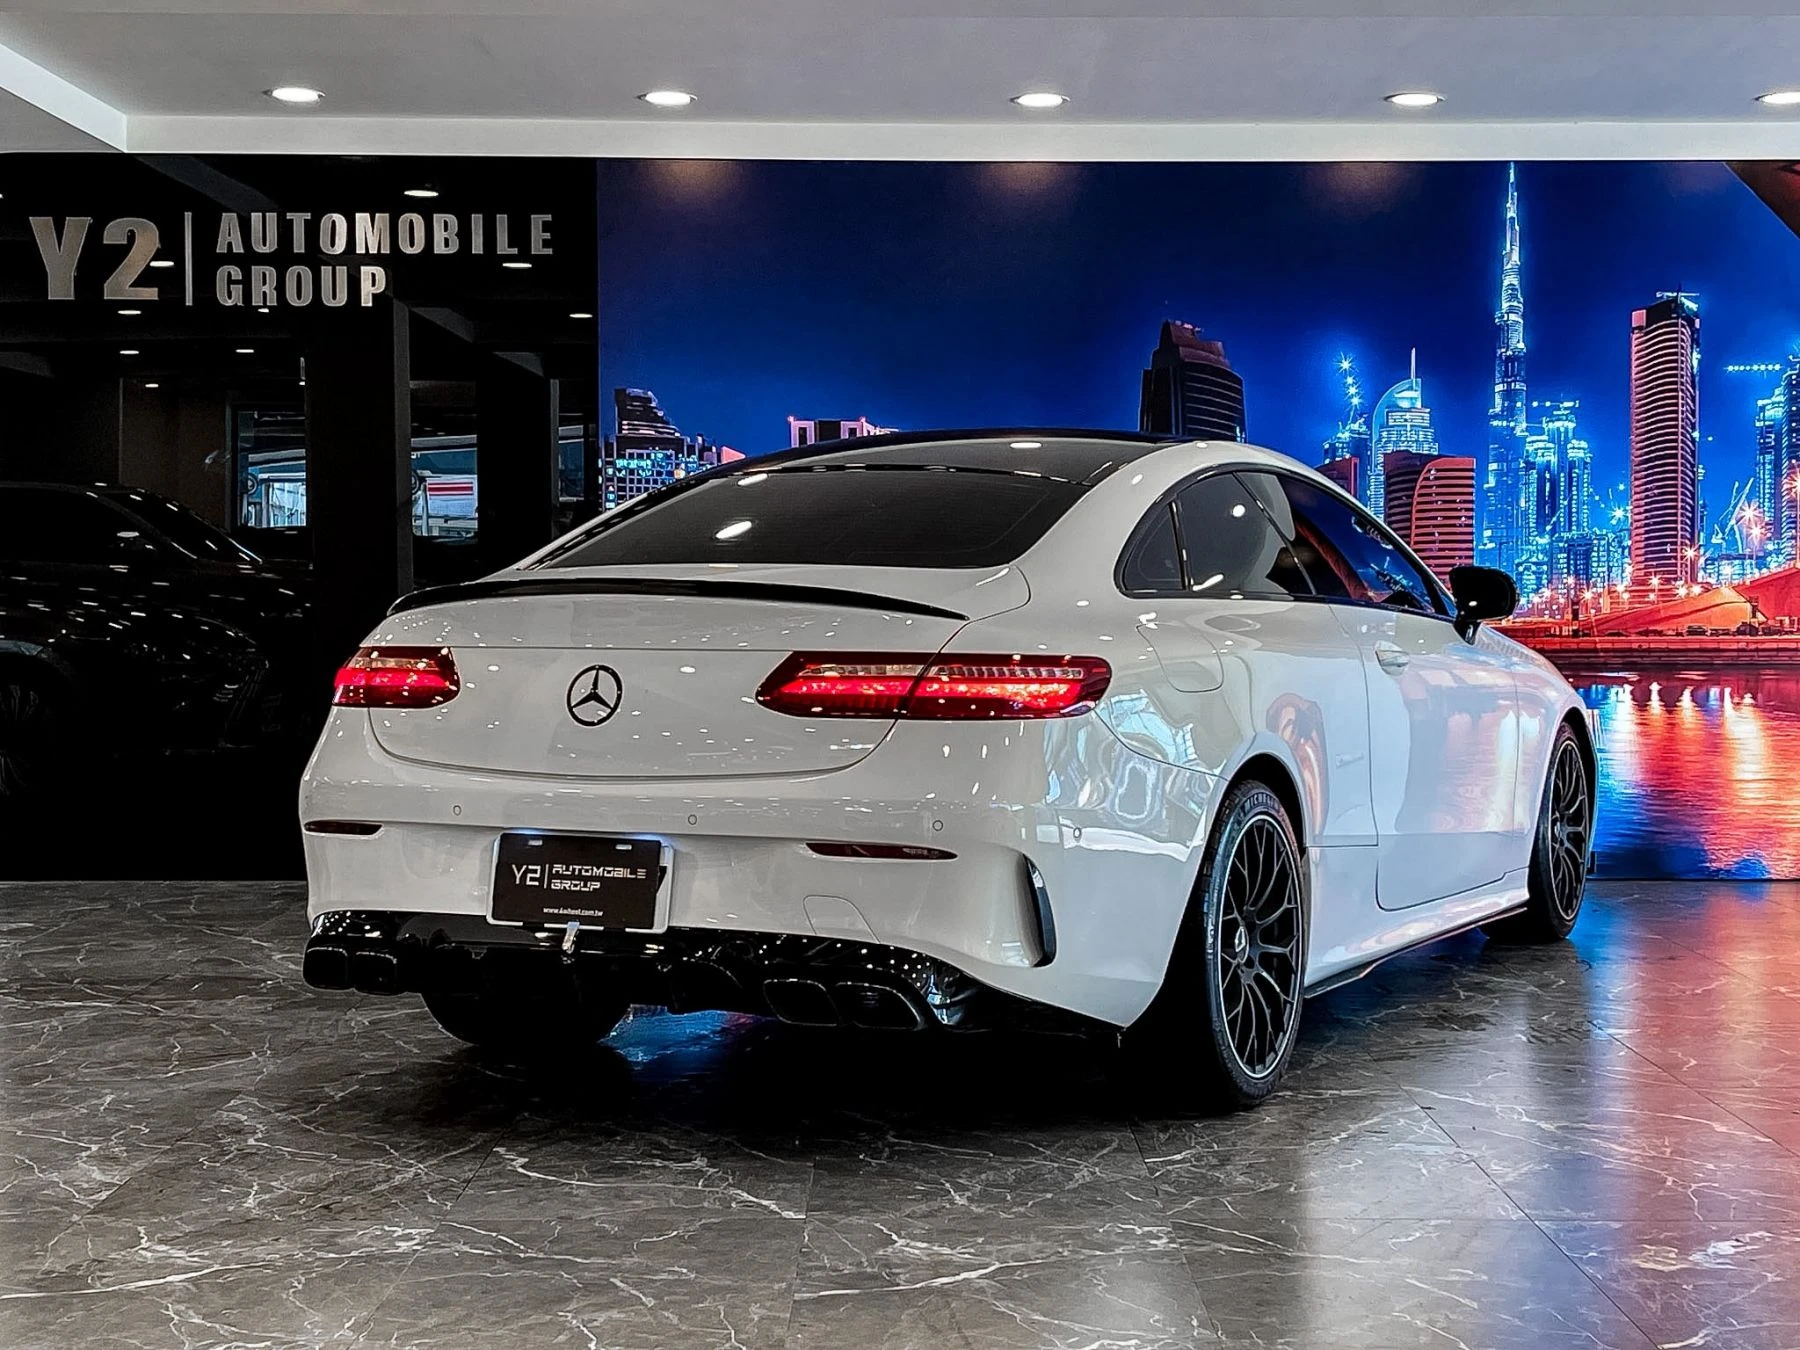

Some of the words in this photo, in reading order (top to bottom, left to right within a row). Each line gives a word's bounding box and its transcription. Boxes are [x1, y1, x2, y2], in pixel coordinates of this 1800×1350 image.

[216, 213, 554, 254] AUTOMOBILE
[29, 217, 159, 300] Y2
[216, 265, 386, 306] GROUP
[511, 863, 541, 886] Y2
[551, 879, 601, 892] GROUP
[552, 863, 647, 879] AUTOMOBILE
